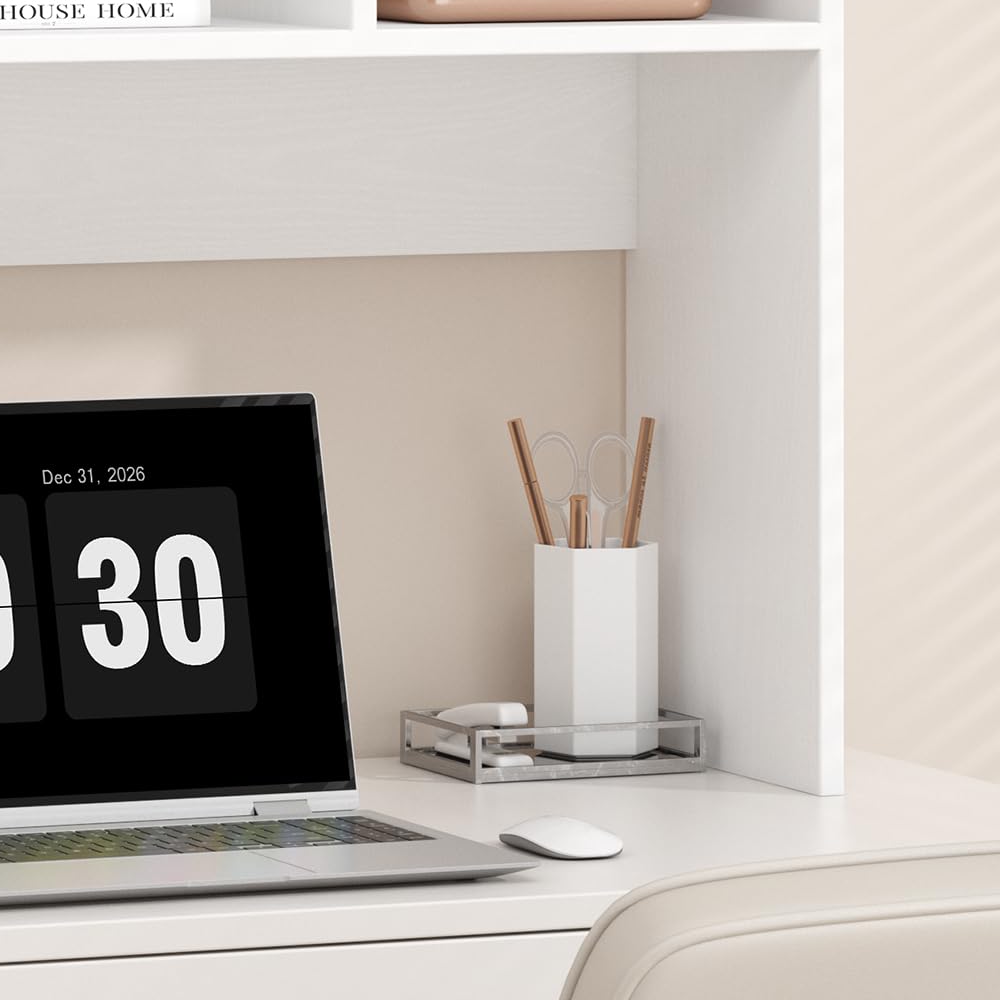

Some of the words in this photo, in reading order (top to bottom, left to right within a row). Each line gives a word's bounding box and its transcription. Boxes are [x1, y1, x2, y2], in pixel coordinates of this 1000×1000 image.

[98, 2, 174, 18] HOME
[42, 470, 72, 484] Dec
[78, 468, 100, 484] 31,
[108, 466, 145, 482] 2026
[78, 534, 225, 669] 30
